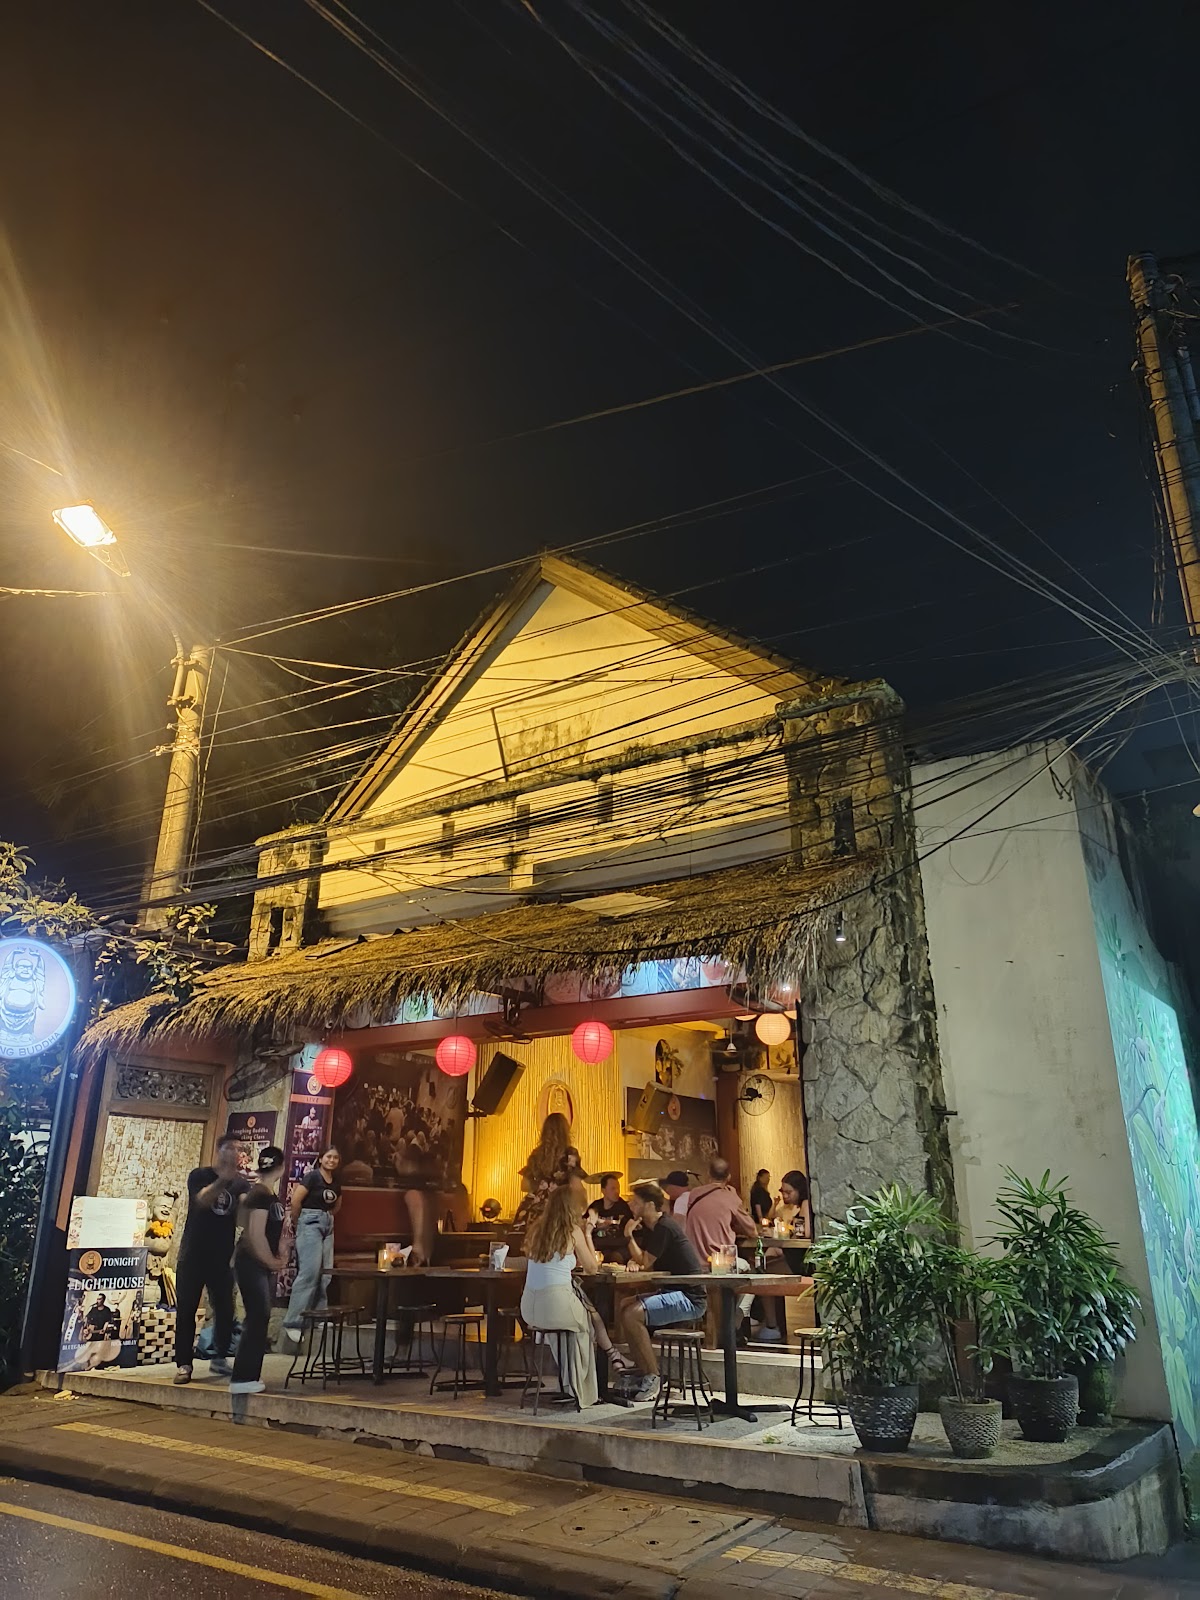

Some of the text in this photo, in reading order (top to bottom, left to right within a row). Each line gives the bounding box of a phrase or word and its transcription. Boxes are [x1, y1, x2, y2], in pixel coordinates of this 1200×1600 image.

[19, 1032, 60, 1056] BUDDHA
[102, 1257, 140, 1267] TONIGHT
[74, 1276, 145, 1291] LIGHTHOUSE
